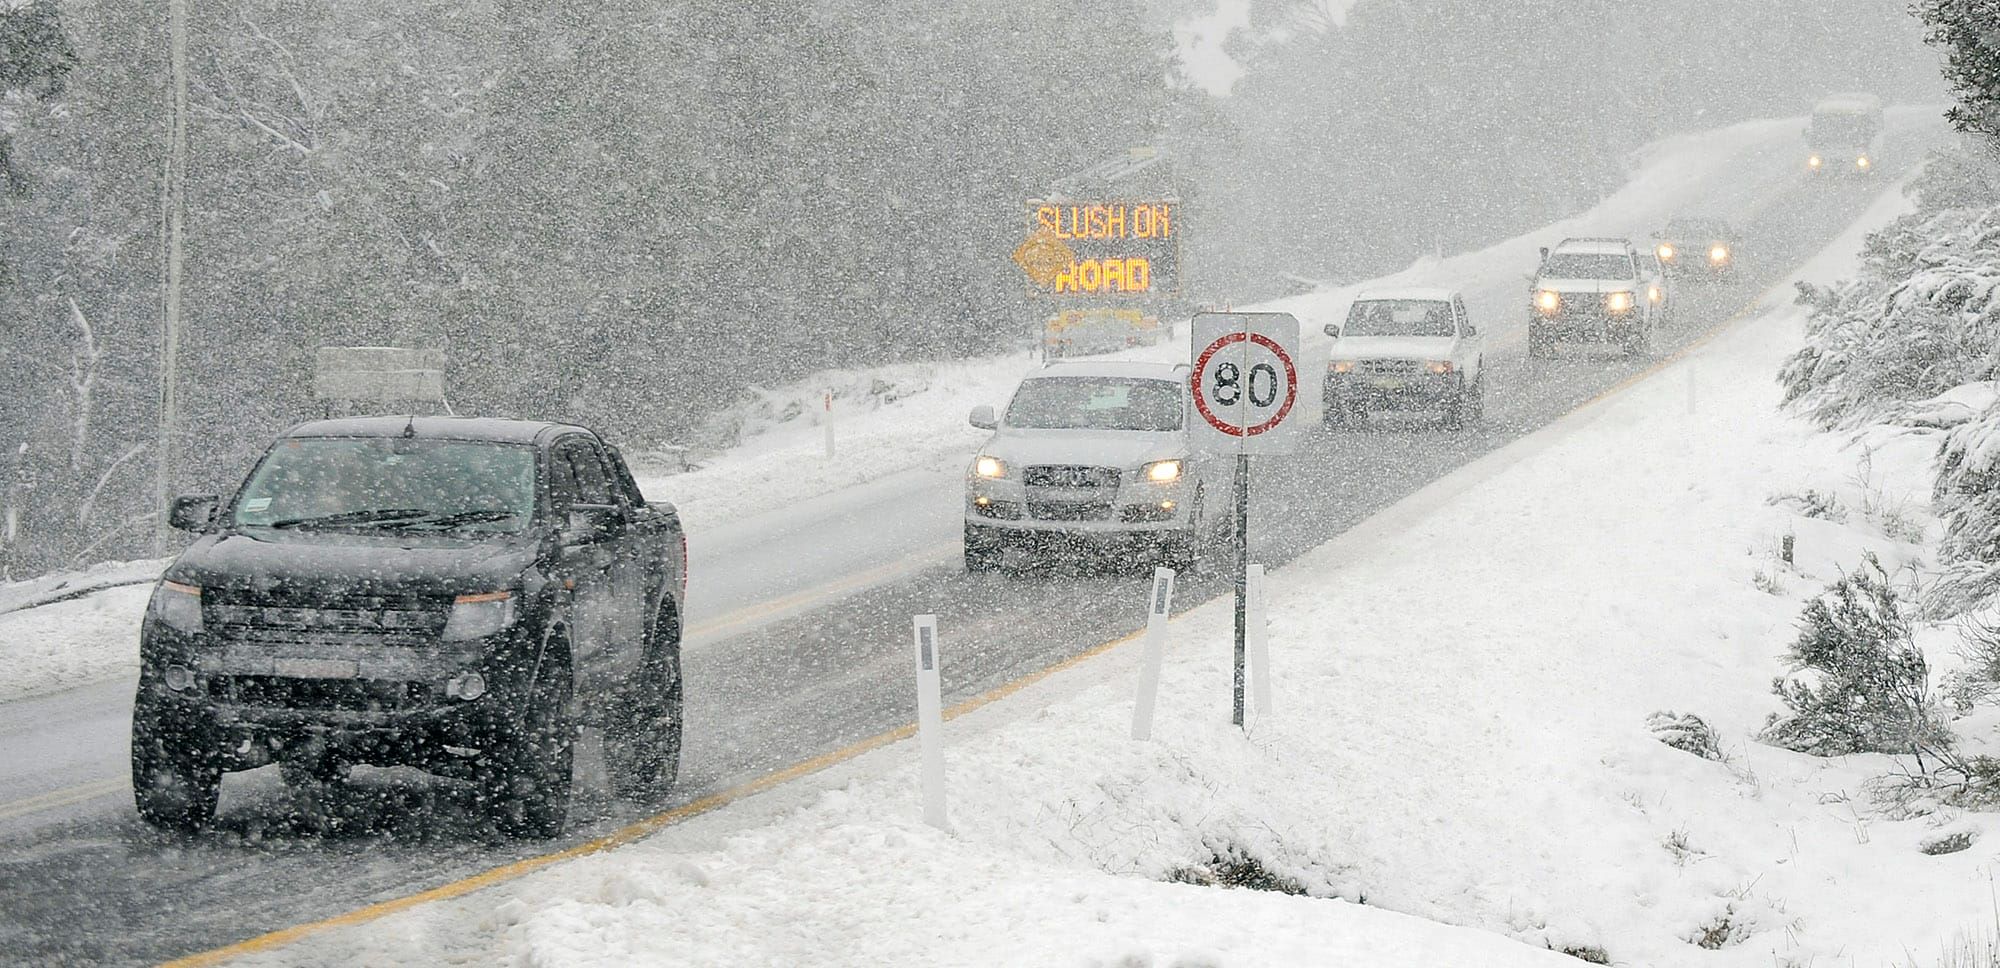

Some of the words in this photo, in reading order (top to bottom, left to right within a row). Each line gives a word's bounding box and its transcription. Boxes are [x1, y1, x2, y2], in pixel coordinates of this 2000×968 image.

[1037, 205, 1126, 239] SLUSH
[1134, 204, 1170, 239] ON
[1212, 362, 1278, 408] 80
